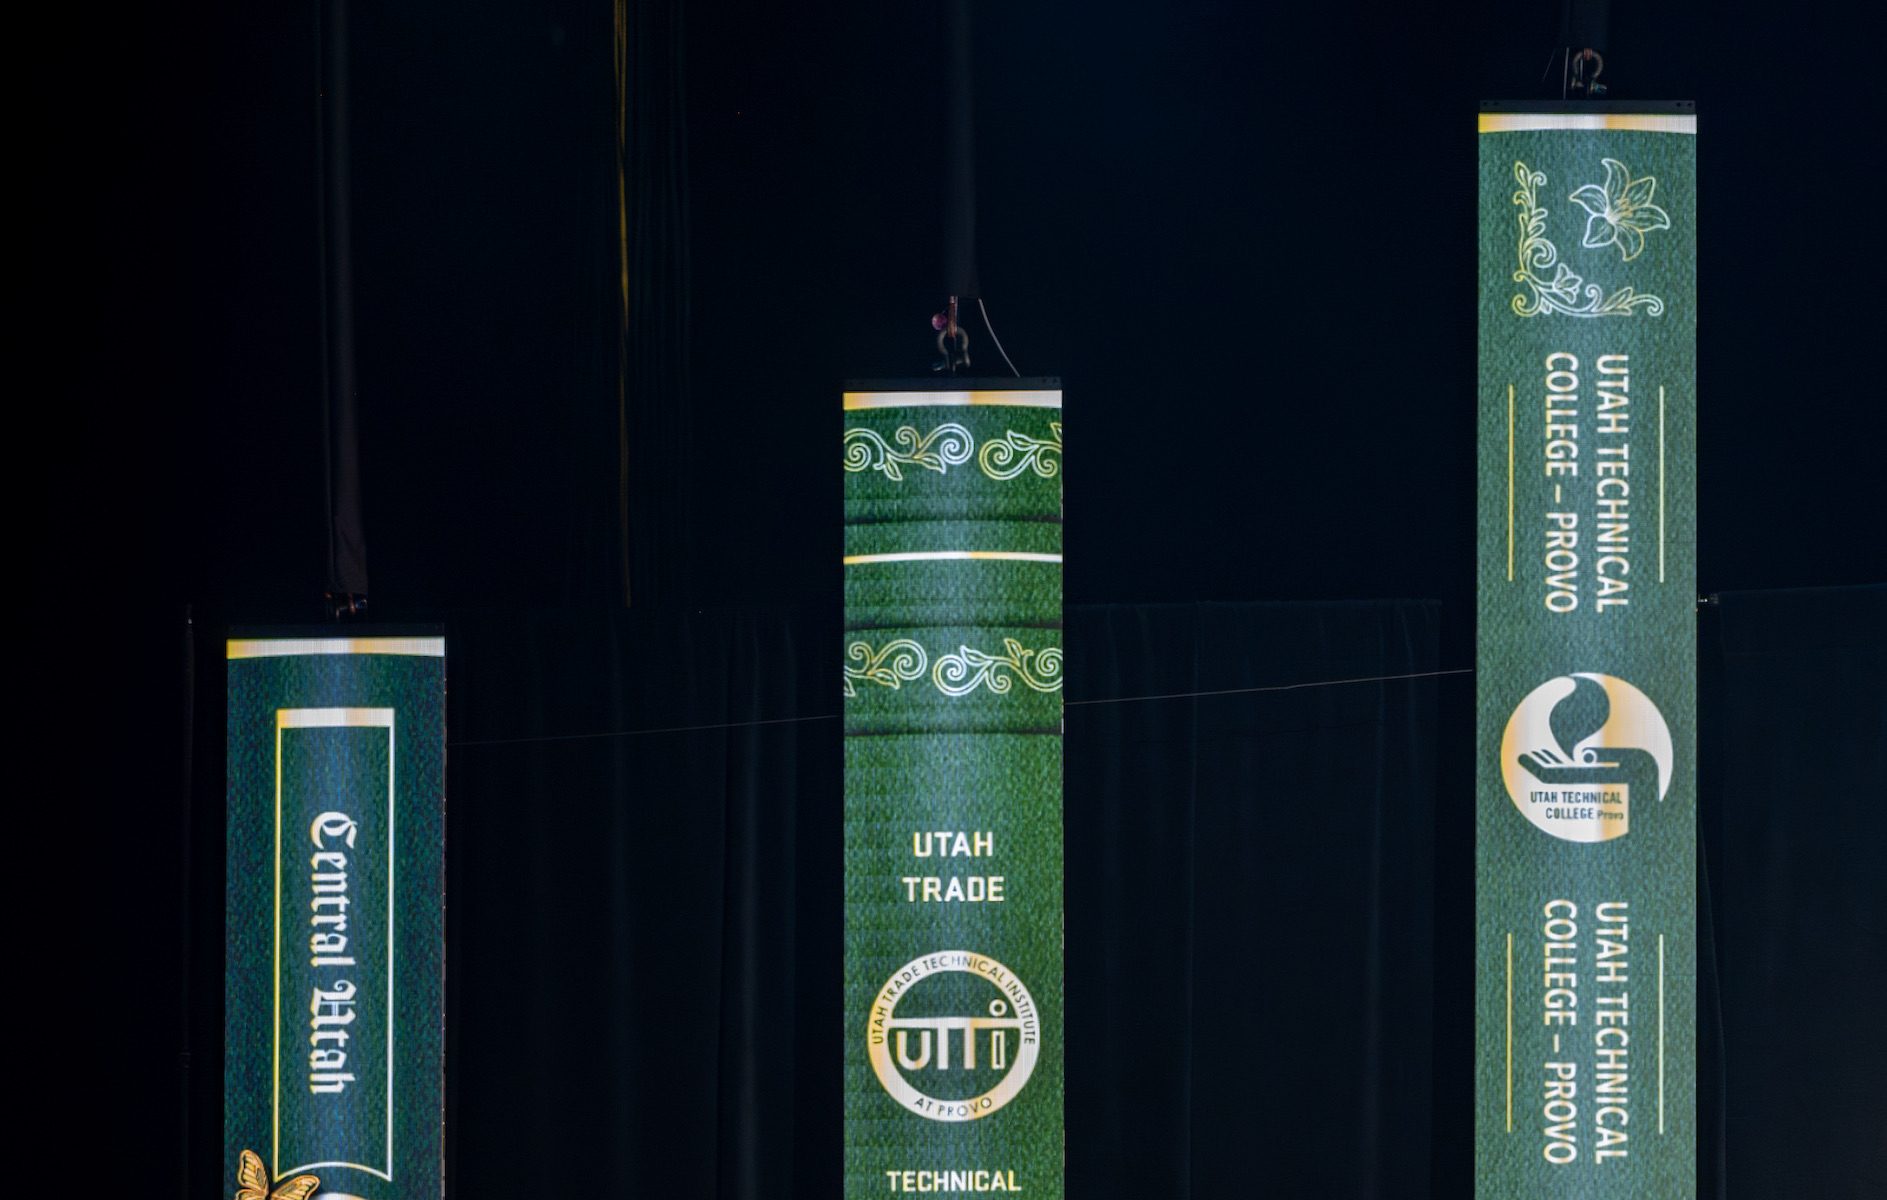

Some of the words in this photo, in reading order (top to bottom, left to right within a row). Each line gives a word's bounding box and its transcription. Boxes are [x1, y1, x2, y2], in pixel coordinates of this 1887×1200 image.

[1545, 352, 1578, 477] COLLEGE
[1596, 354, 1629, 434] UTAH
[1545, 512, 1578, 613] PROVO
[1596, 444, 1629, 613] TECHNICAL
[1530, 791, 1557, 803] UTAH
[1562, 791, 1622, 804] TECHNICAL
[1546, 808, 1594, 819] COLLEGE
[1597, 810, 1624, 821] Provo
[309, 811, 358, 967] Central
[902, 876, 1005, 902] TRADE
[913, 832, 994, 858] UTAH
[1544, 899, 1577, 1026] COLLEGE
[1596, 902, 1628, 982] UTAH
[309, 980, 357, 1094] Utah
[872, 1007, 887, 1044] UTAH
[887, 966, 920, 1002] TRADE
[924, 955, 1006, 982] TECHNICAL
[1005, 981, 1036, 1045] INSTITUTE
[915, 1097, 933, 1111] AT
[937, 1097, 992, 1116] PROVO
[1544, 1062, 1577, 1164] PROVO
[1596, 992, 1628, 1164] TECHNICAL
[887, 1171, 1021, 1192] TECHNICAL
